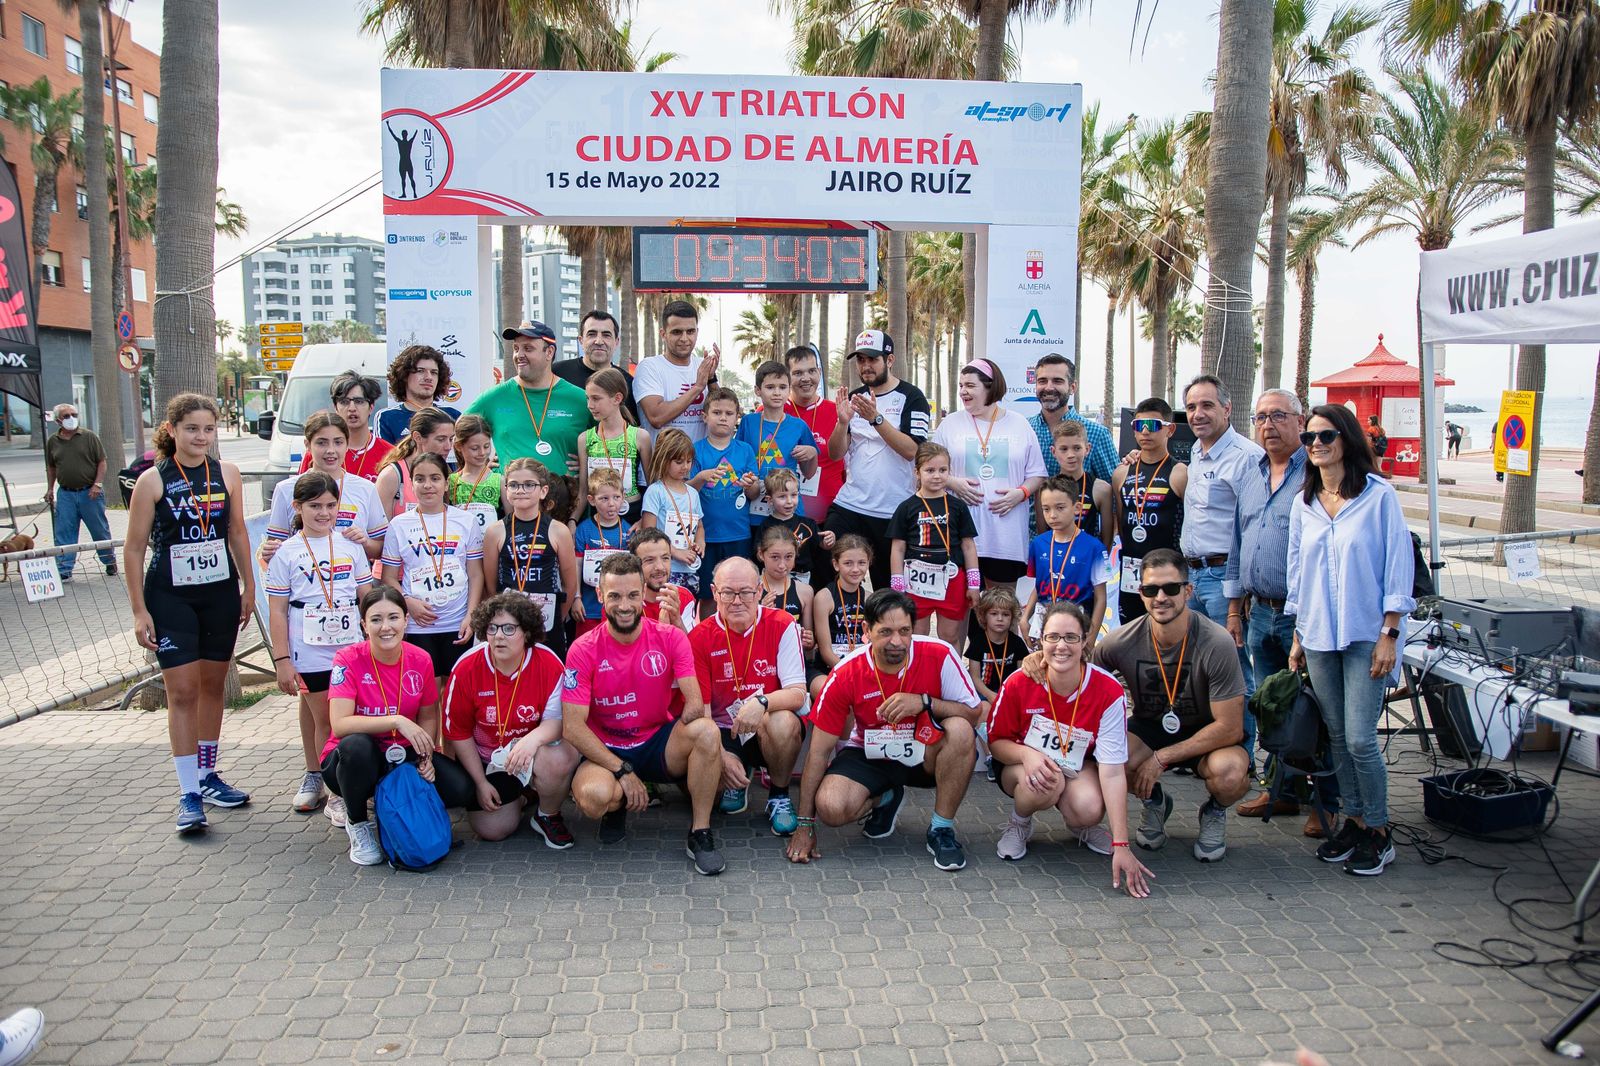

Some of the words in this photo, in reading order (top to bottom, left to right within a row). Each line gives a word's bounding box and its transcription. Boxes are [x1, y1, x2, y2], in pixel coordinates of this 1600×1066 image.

[651, 91, 703, 117] XV
[712, 86, 905, 119] TRIATLÓN
[575, 136, 732, 162] CIUDAD
[745, 134, 794, 161] DE
[805, 134, 979, 165] ALMERÍA
[546, 172, 569, 189] 15
[576, 171, 602, 189] de
[609, 172, 664, 194] Mayo
[669, 172, 719, 189] 2022
[825, 170, 903, 192] JAIRO
[911, 168, 972, 194] RUÍZ
[1018, 282, 1051, 290] ALMERÍA
[1447, 252, 1600, 315] www.cruz
[1128, 512, 1158, 526] PABLO
[181, 524, 217, 540] LOLA
[187, 554, 218, 571] 190
[28, 570, 53, 582] RENTA
[424, 573, 455, 591] 183
[911, 570, 935, 586] 201
[319, 615, 350, 631] 16
[594, 692, 637, 706] HUUB
[616, 710, 638, 719] going
